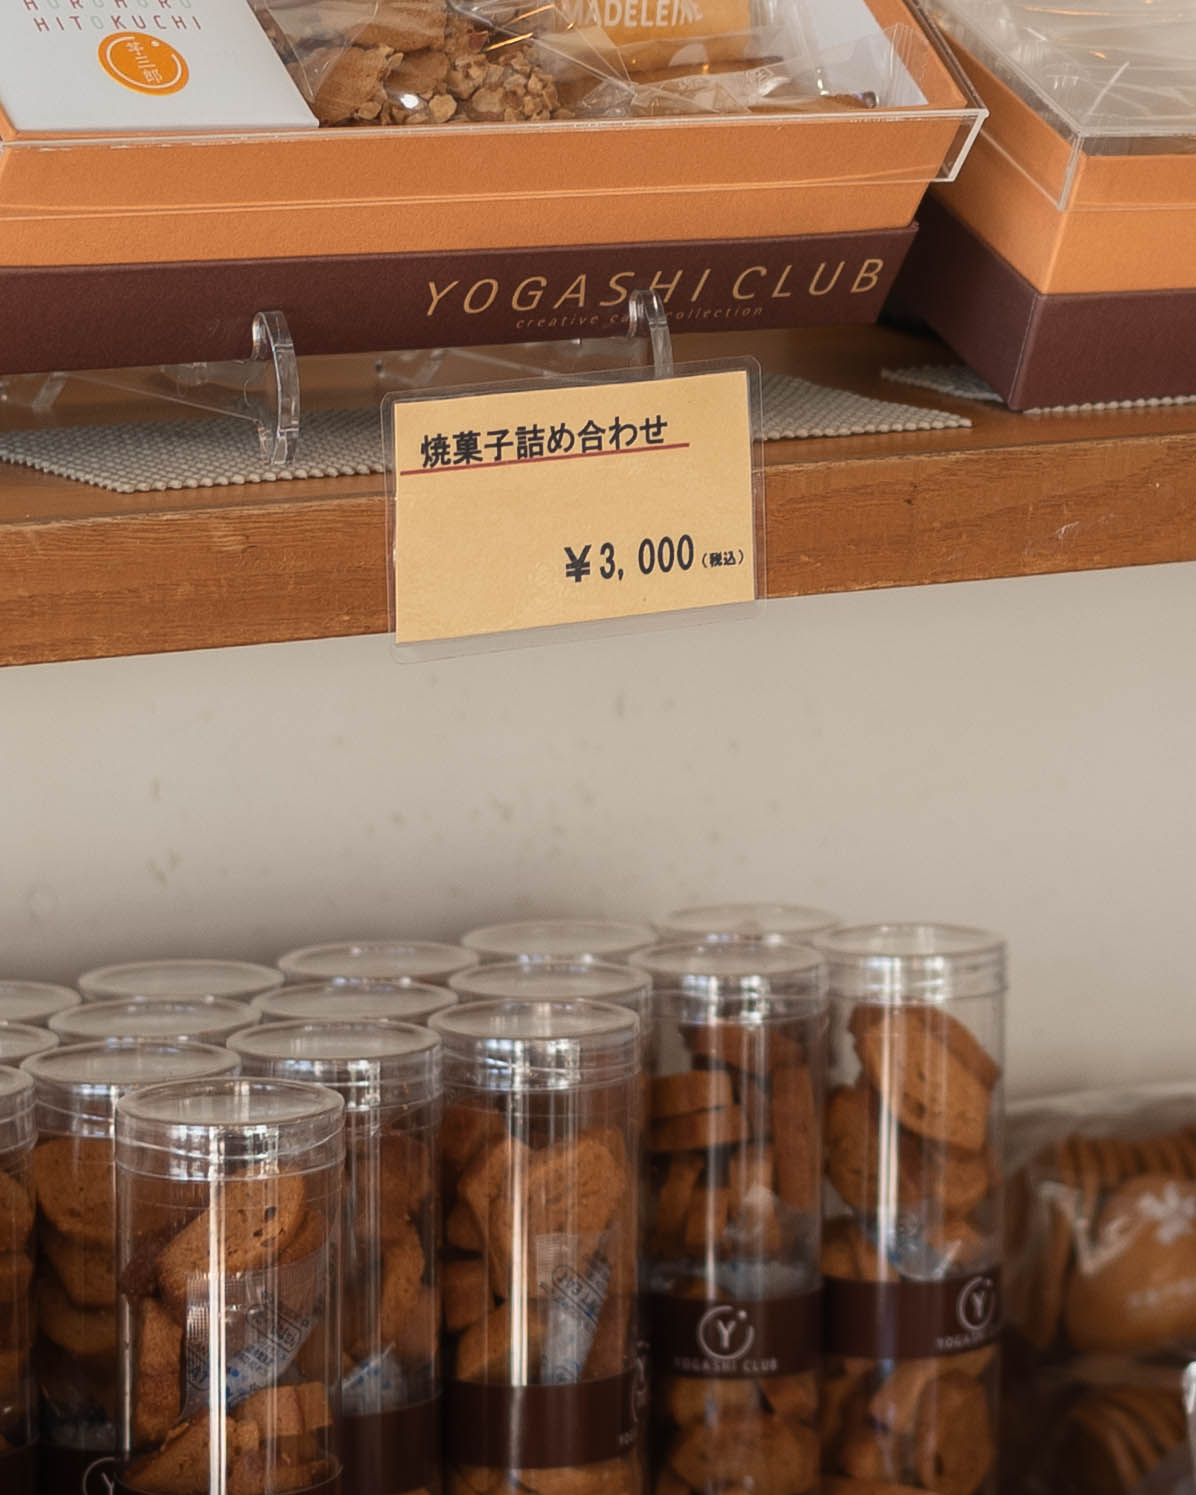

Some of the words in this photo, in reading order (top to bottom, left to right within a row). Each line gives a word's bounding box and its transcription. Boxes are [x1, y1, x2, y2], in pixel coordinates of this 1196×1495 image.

[33, 15, 201, 32] HITOKUCHI
[425, 268, 710, 316] YOGASHI
[732, 257, 885, 300] CLUB
[516, 313, 599, 330] creative
[420, 415, 668, 469] 焼菓子詰め合わせ
[564, 534, 695, 583] ¥3,000
